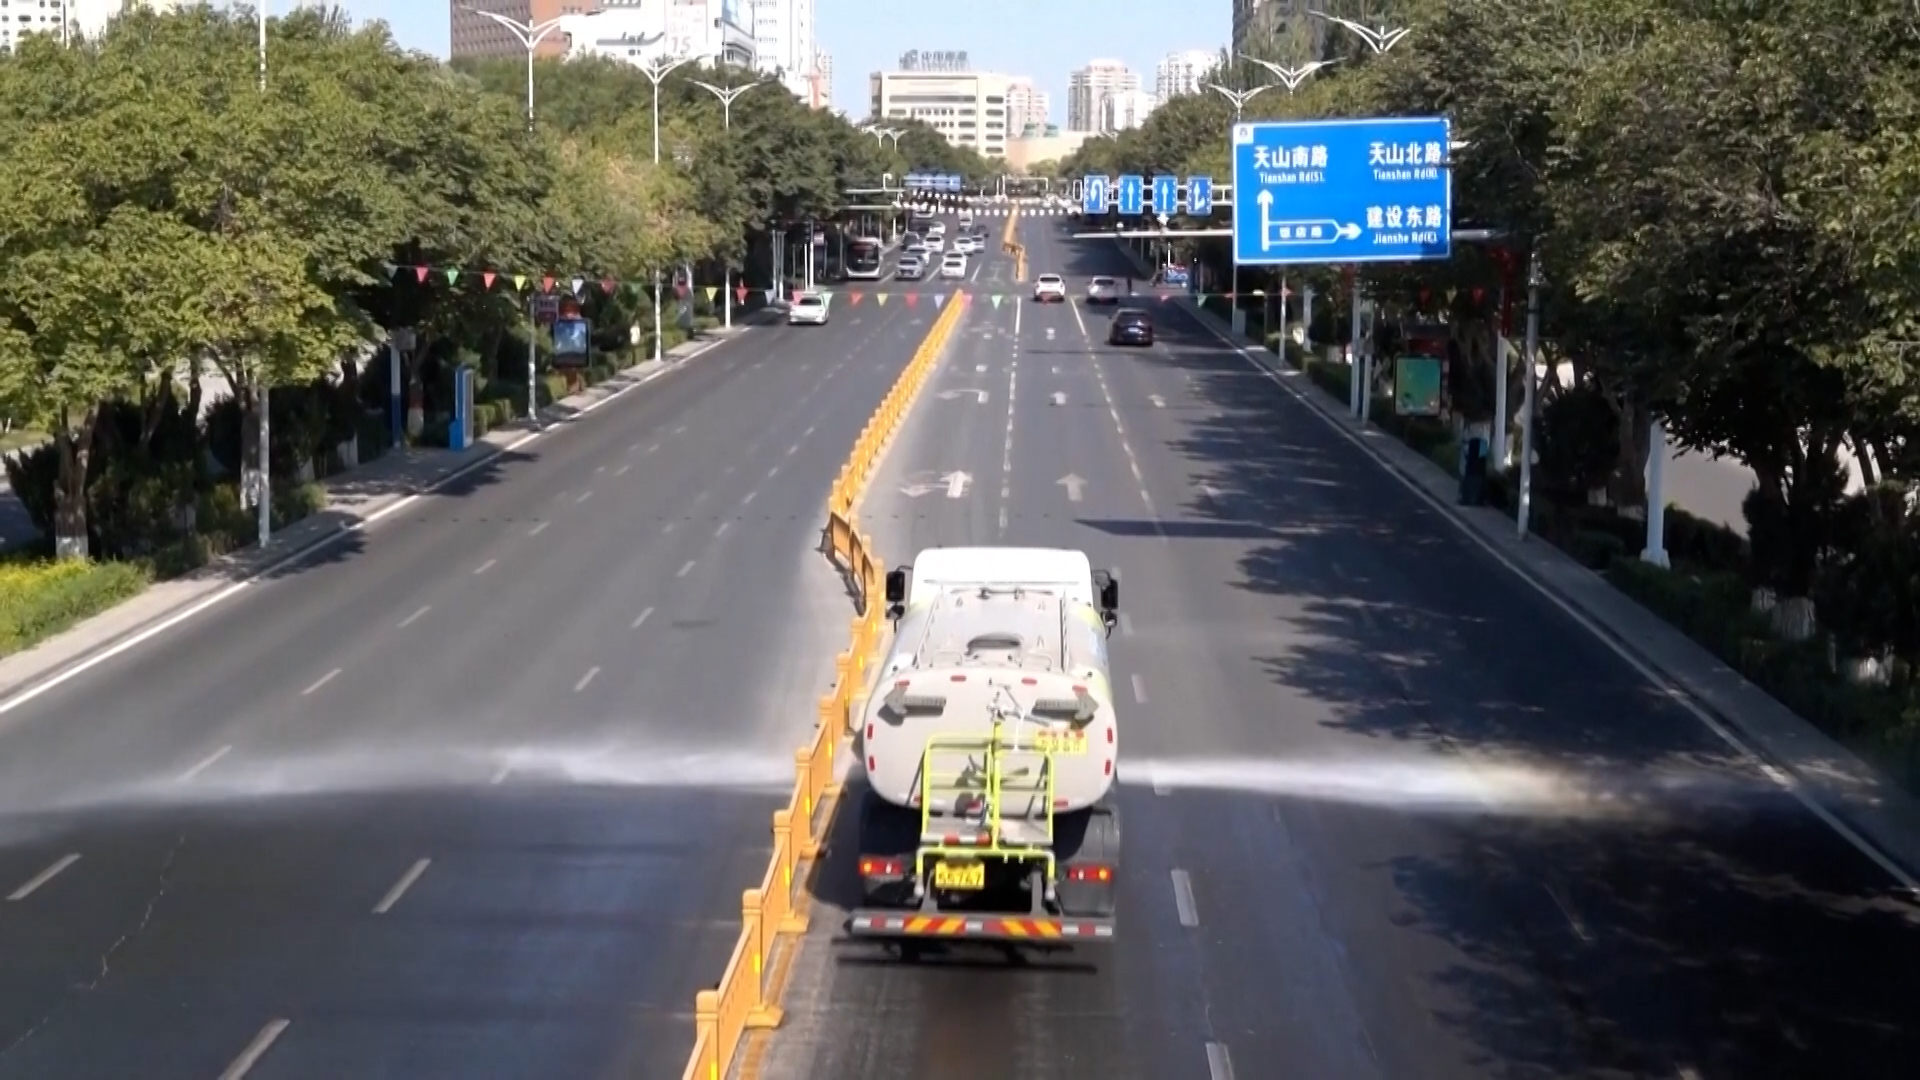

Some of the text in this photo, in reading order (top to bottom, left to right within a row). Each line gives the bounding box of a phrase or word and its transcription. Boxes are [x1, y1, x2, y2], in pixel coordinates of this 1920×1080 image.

[1253, 145, 1328, 169] 天山南路
[1368, 141, 1442, 165] 天山北路
[1259, 171, 1297, 183] Tianshan
[1373, 168, 1411, 180] Tianshan
[1366, 204, 1442, 229] 建设东路
[1373, 232, 1409, 244] Jianshe
